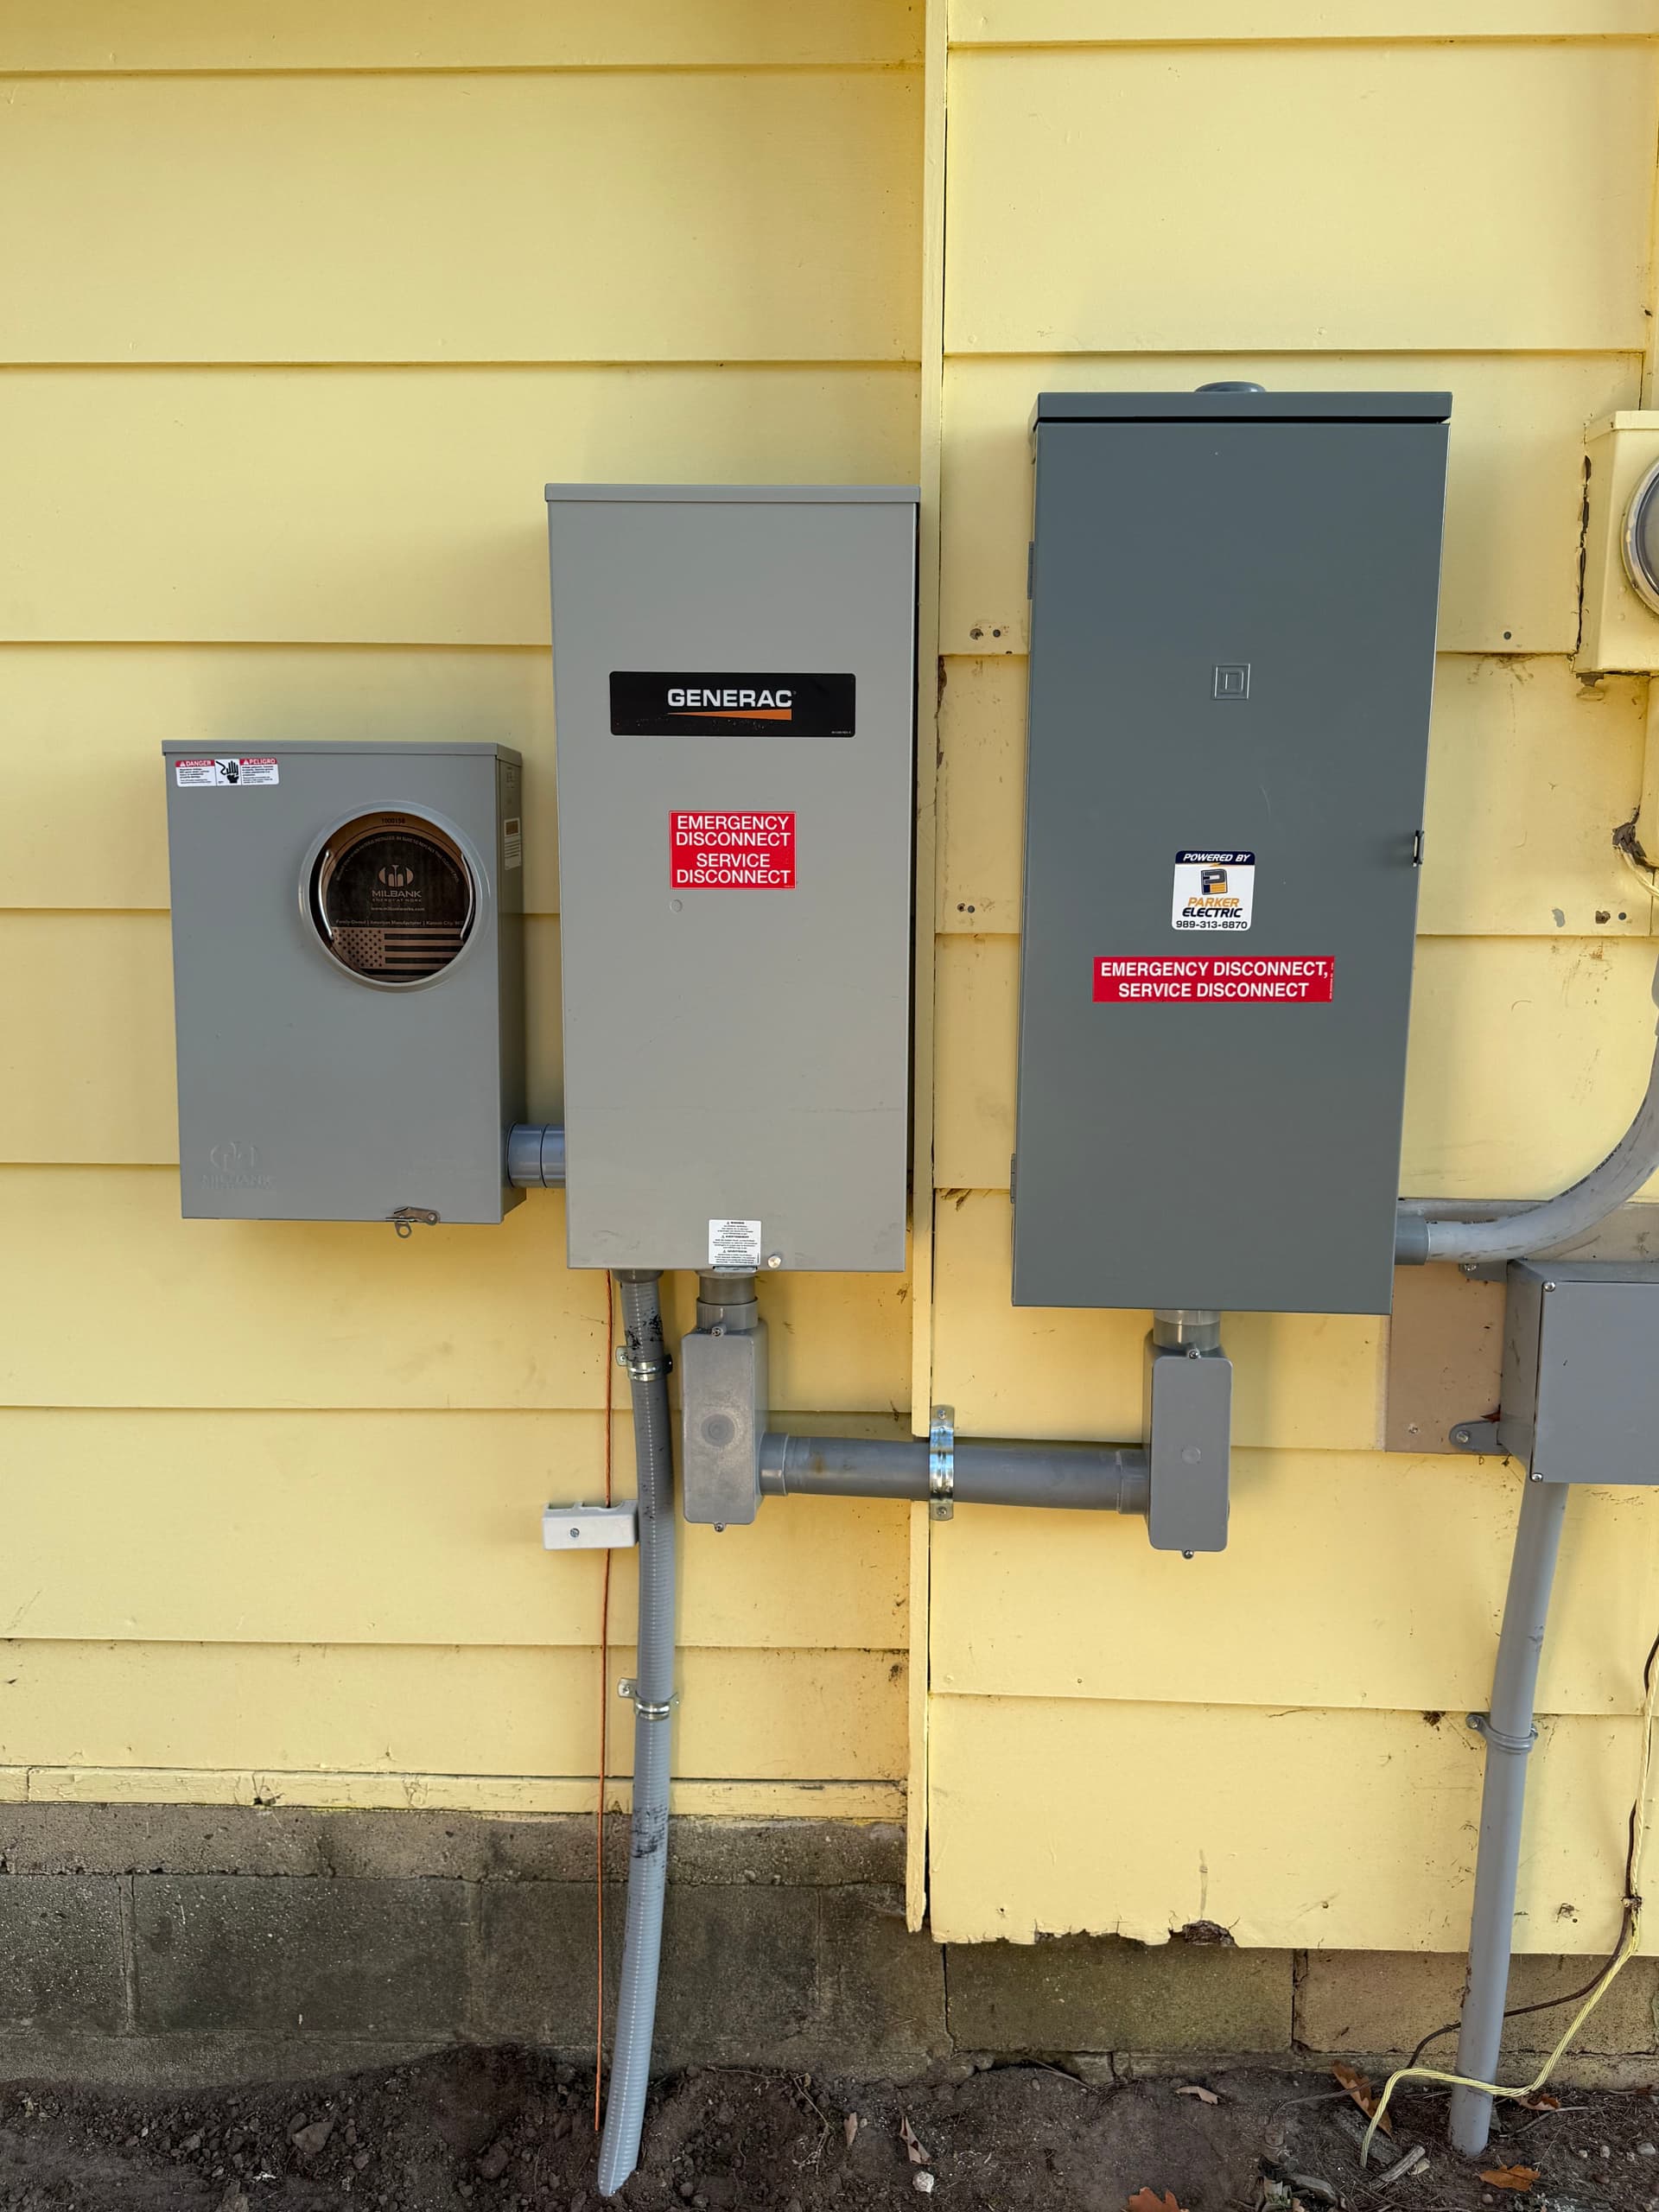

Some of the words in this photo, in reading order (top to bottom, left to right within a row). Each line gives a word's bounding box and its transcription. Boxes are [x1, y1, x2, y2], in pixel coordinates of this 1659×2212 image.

[667, 689, 792, 708] GENERAC
[677, 815, 790, 830] EMERGENCY
[676, 831, 791, 847] DISCONNECT
[696, 853, 771, 868] SERVICE
[1183, 853, 1233, 862] POWERED
[1235, 854, 1251, 862] BY
[676, 869, 791, 885] DISCONNECT
[1187, 897, 1240, 908] PARKER
[1182, 907, 1243, 918] ELECTRIC
[1175, 920, 1248, 930] 989-313-6870
[1101, 962, 1210, 977] EMERGENCY
[1213, 961, 1329, 979] DISCONNECT,
[1118, 982, 1192, 998] SERVICE
[1196, 982, 1310, 998] DISCONNECT
